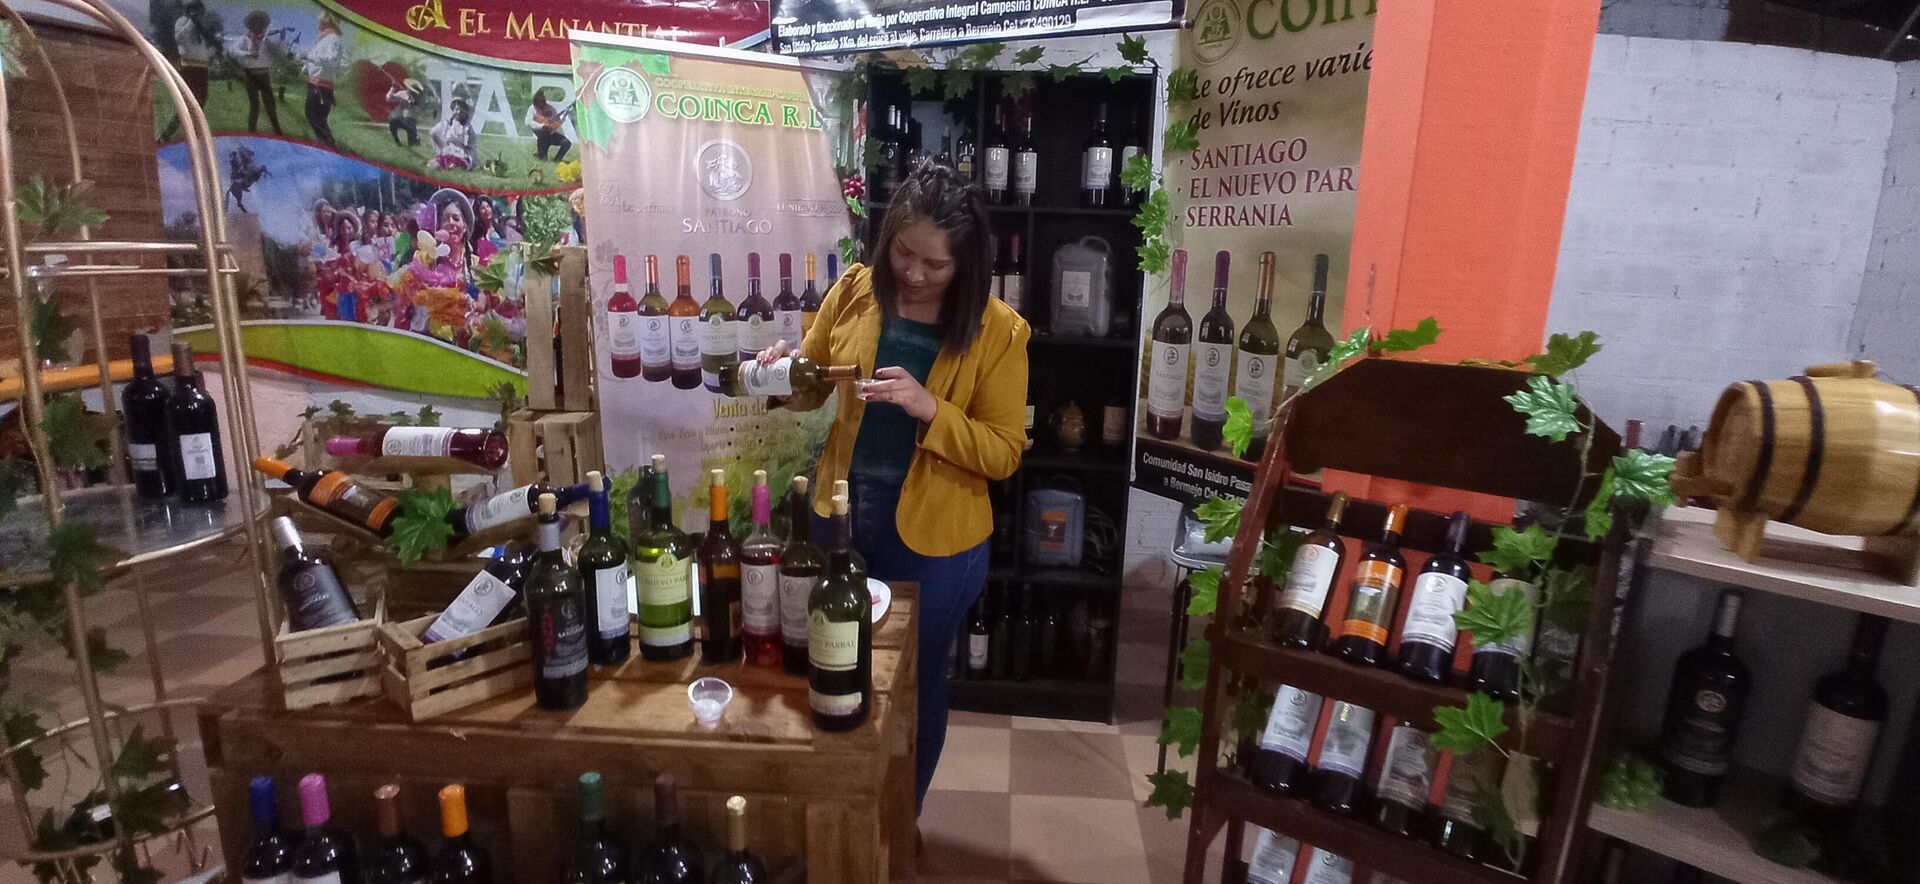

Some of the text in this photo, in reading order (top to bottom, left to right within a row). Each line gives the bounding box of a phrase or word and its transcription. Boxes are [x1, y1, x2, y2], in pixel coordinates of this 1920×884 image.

[458, 8, 491, 37] EL
[778, 22, 811, 37] Elaborado
[811, 24, 816, 36] y
[816, 18, 855, 34] fraccionado
[855, 18, 865, 30] en
[886, 13, 898, 29] por
[899, 9, 945, 25] Cooperativa
[945, 3, 979, 19] Integral
[980, 0, 1031, 14] Campesina
[779, 42, 792, 54] San
[810, 37, 839, 51] Pasando
[856, 33, 868, 48] del
[1217, 64, 1296, 98] ofrece
[655, 92, 774, 125] COINCA
[1189, 100, 1281, 131] de Vinos
[1190, 137, 1308, 171] SANTIAGO
[1189, 177, 1211, 198] EL
[1217, 170, 1297, 198] NUEVO
[682, 218, 773, 235] SANTIAGO
[704, 207, 751, 219] PATRONO
[1185, 203, 1293, 227] SERRANIA
[714, 398, 748, 419] Venta
[1143, 452, 1187, 474] Comunidad
[1187, 463, 1204, 480] San
[1204, 468, 1228, 486] Isidro
[1170, 476, 1202, 497] Bermejo
